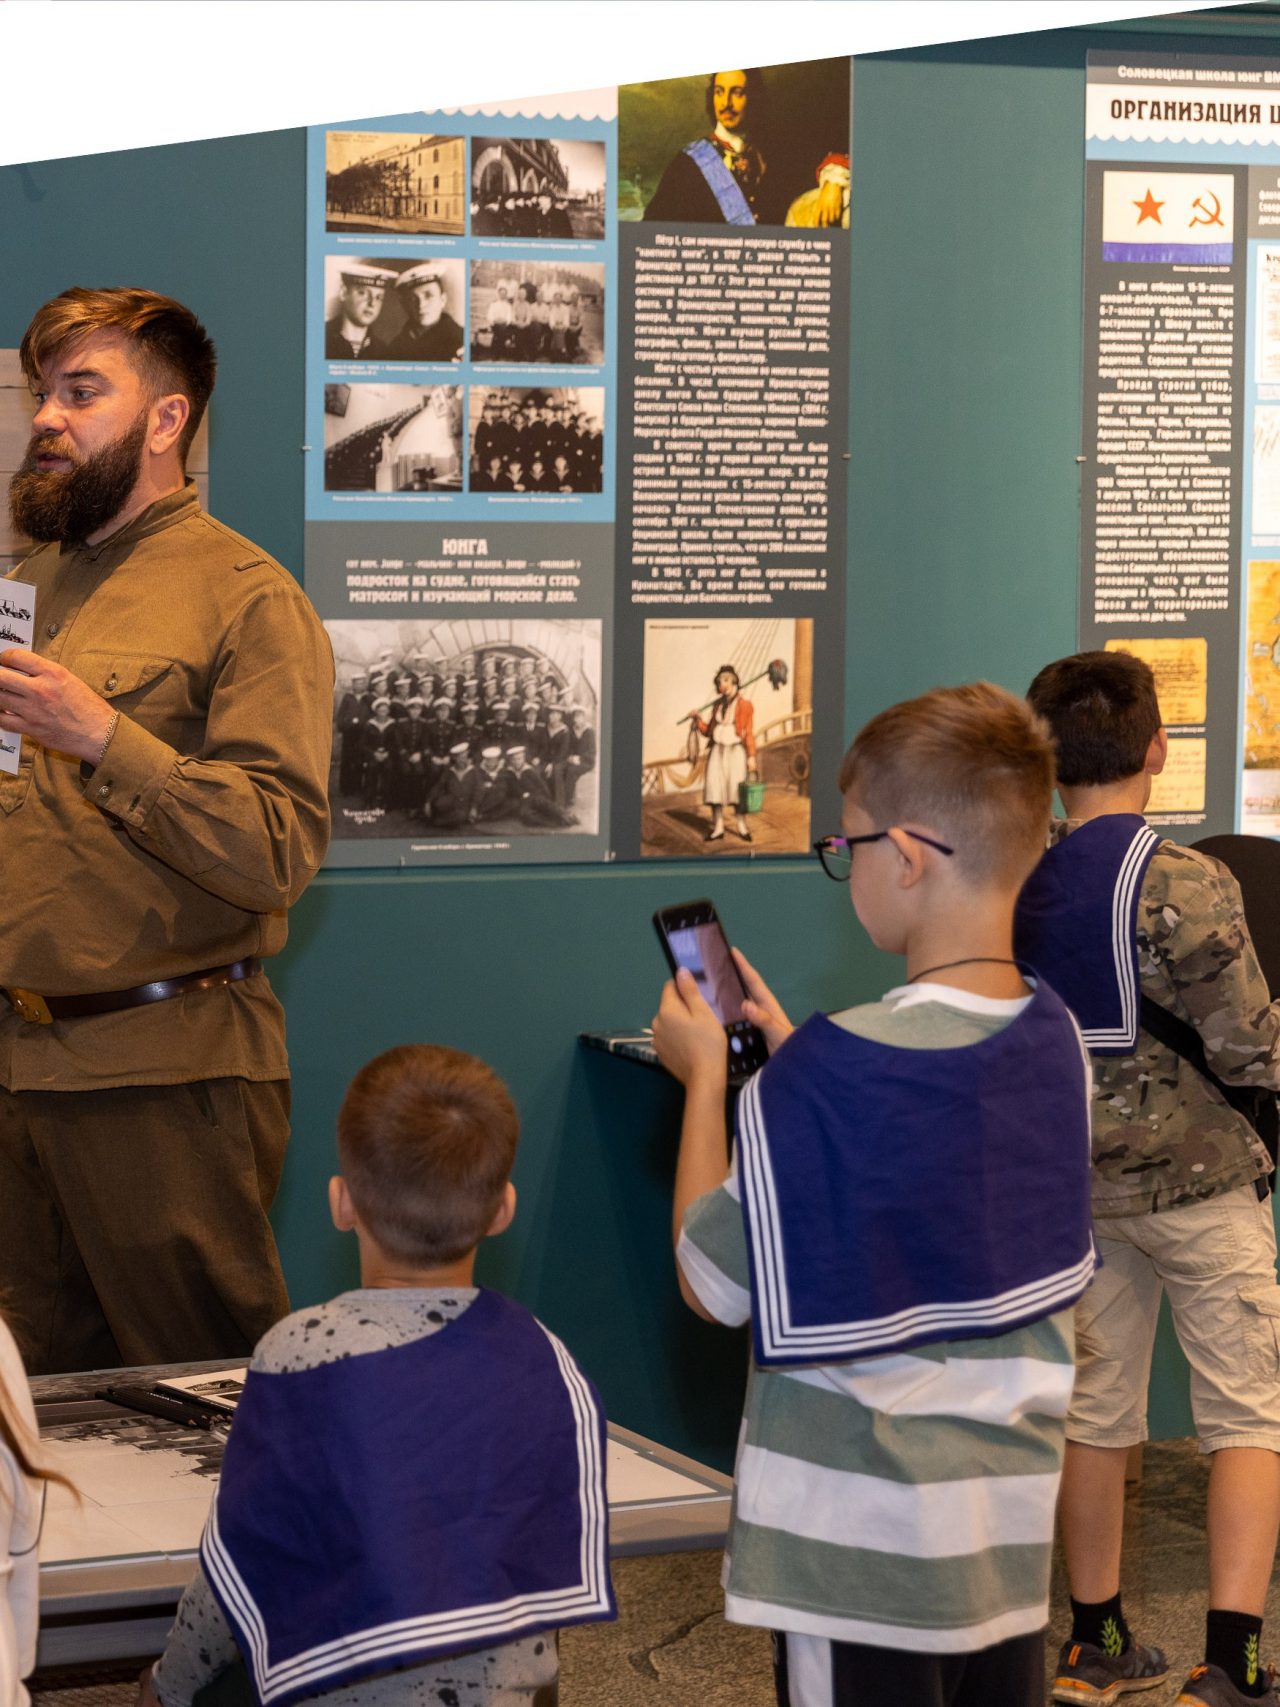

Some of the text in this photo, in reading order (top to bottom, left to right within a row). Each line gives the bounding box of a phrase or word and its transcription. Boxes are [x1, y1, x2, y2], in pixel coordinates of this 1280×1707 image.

[1117, 66, 1193, 81] Соловецкая
[1195, 70, 1236, 82] школа
[1237, 72, 1263, 83] юнг
[1111, 100, 1260, 124] ОРГАНИЗАЦИЯ
[443, 539, 488, 555] ЮНГА
